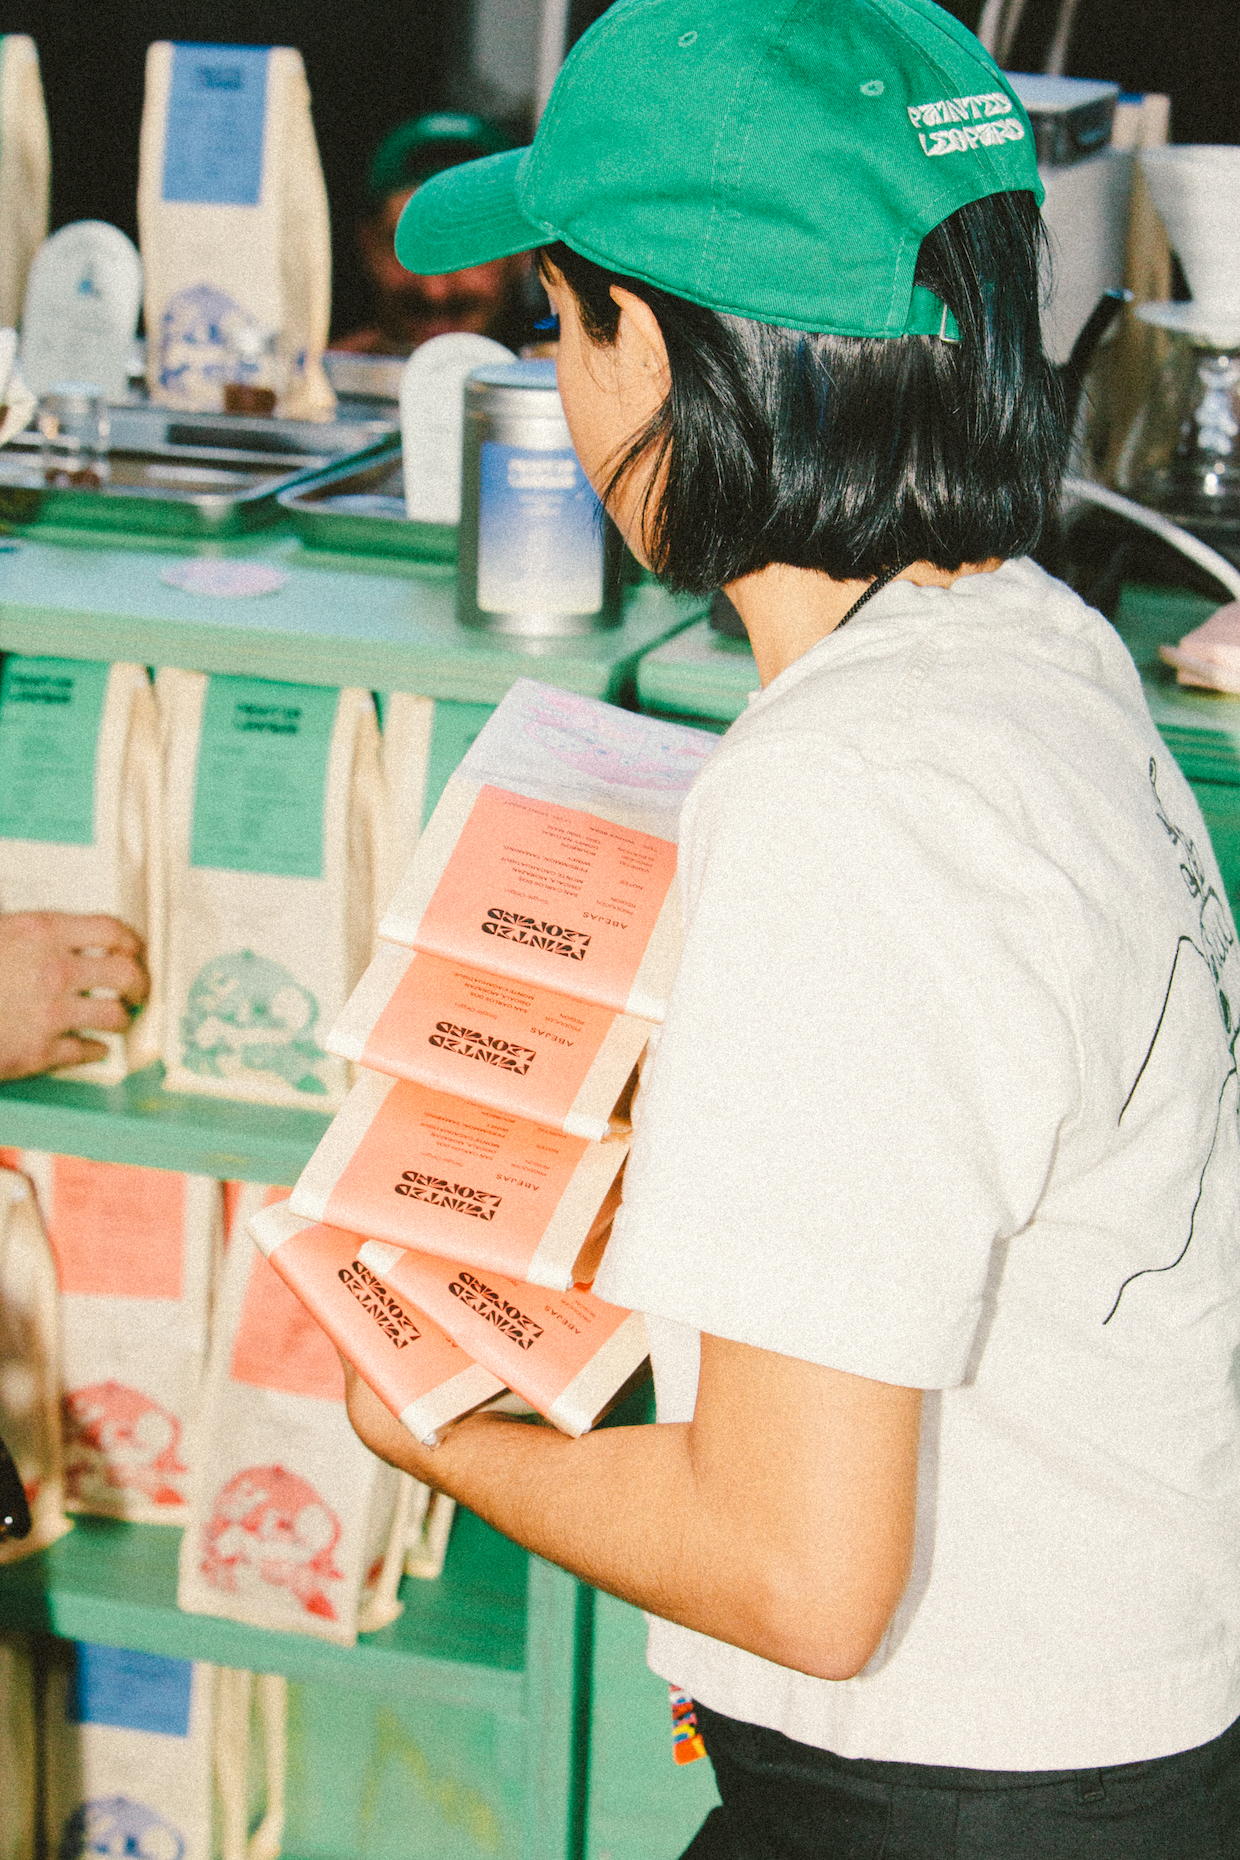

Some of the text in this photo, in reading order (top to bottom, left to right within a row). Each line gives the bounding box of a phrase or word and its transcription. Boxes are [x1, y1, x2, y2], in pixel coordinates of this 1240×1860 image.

[907, 92, 1012, 128] PAINTED
[918, 118, 1025, 157] LEOPARD
[557, 872, 584, 884] MONTE
[563, 889, 578, 897] SAN
[486, 907, 591, 946] LEOPARD
[582, 911, 628, 929] ABEJAS
[480, 921, 586, 960] PAINTED
[509, 989, 534, 1000] MONTE
[513, 1005, 528, 1013] SAN
[427, 1033, 530, 1075] PAINTED
[435, 1020, 536, 1062] LEOPARD
[529, 1026, 574, 1047] ABEJAS
[401, 1170, 502, 1207] LEOPARD
[495, 1173, 540, 1191] ABEJAS
[393, 1182, 496, 1221] PAINTED
[337, 1268, 408, 1348] PAINTED
[350, 1259, 421, 1341] LEOPARD
[447, 1281, 534, 1349] PAINTED
[457, 1271, 544, 1338] LEOPARD
[543, 1304, 581, 1334] ABEJAS
